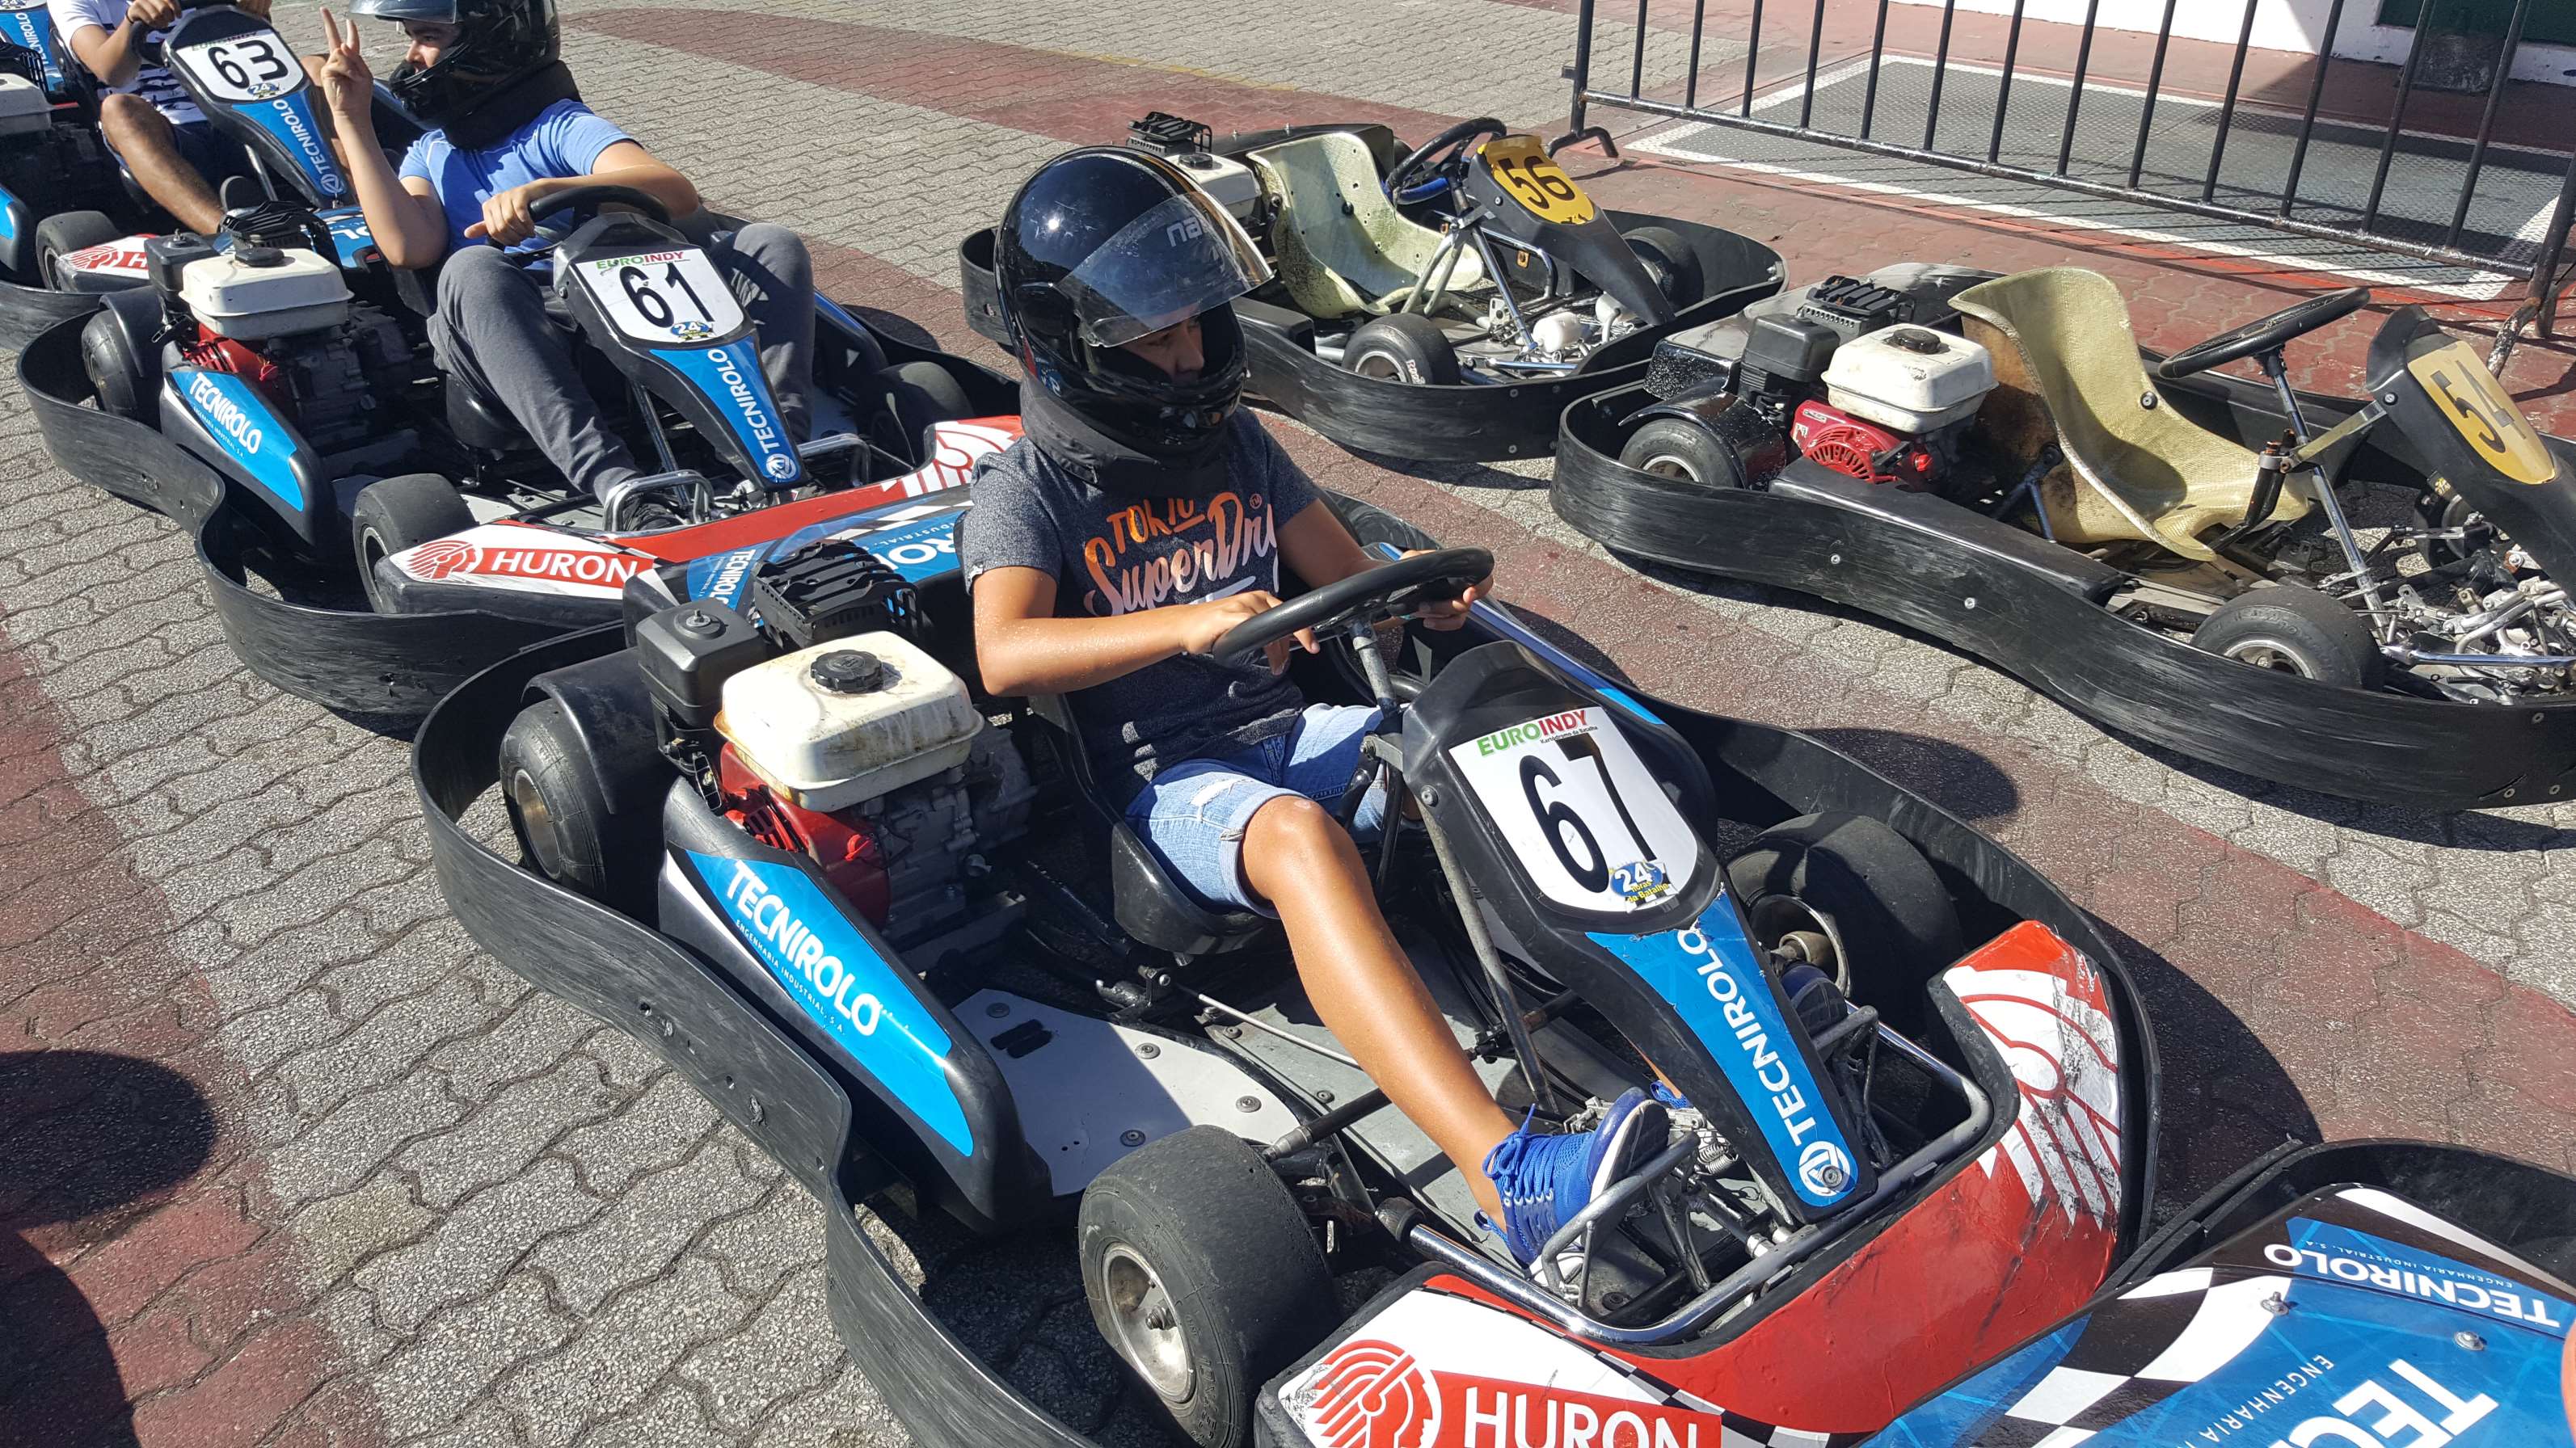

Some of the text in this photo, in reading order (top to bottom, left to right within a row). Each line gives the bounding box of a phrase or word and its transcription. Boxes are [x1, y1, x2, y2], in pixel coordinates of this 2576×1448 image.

[207, 40, 289, 89] 63
[272, 99, 330, 174] TECNIROLO
[1498, 156, 1575, 209] 56
[596, 251, 685, 270] EUROINDY
[619, 262, 715, 328] 61
[674, 322, 702, 335] 24
[189, 372, 263, 454] TECNIROLO
[707, 348, 781, 454] TECNIROLO
[2430, 360, 2527, 453] 54
[491, 550, 638, 583] HURON
[1476, 709, 1587, 756] EUROINDY
[1520, 732, 1657, 894] 67
[1614, 862, 1653, 893] 24
[726, 860, 881, 1037] TECNIROLO
[736, 919, 779, 969] ENGENHARIA
[1676, 927, 1815, 1147] TECNIROLO
[2263, 1244, 2561, 1328] TECNIROLO
[2421, 1263, 2512, 1288] ENGENHARIA
[1464, 1386, 1698, 1448] HURON
[2198, 1354, 2335, 1442] ENGENHARIA
